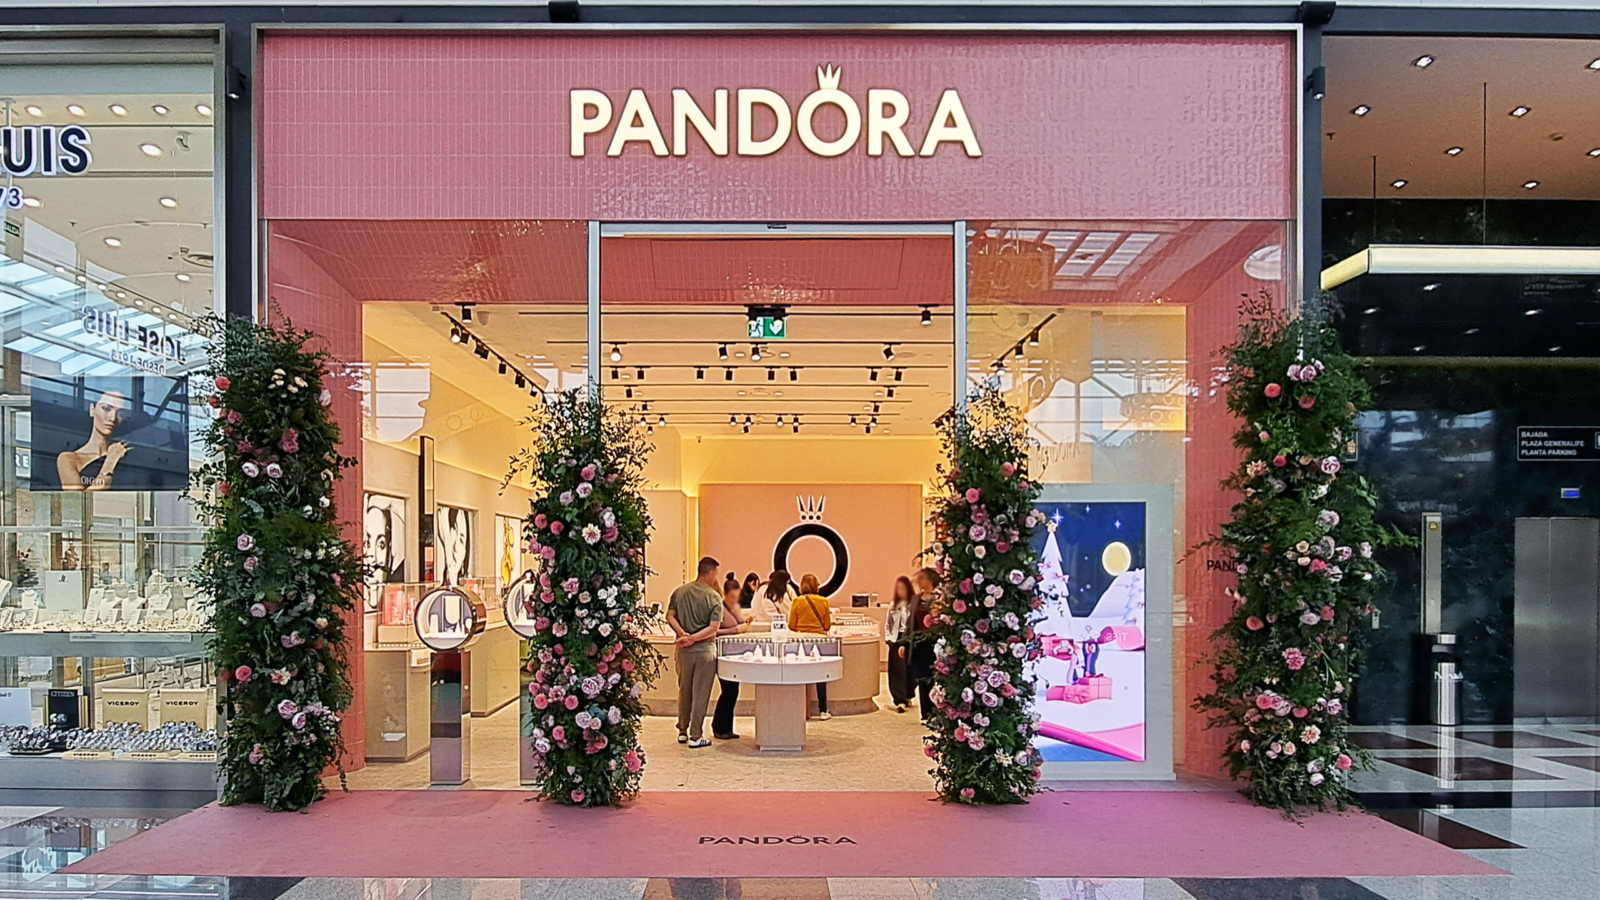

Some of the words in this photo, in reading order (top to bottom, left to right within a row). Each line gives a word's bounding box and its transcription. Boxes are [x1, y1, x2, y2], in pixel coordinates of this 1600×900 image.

[569, 84, 983, 158] PANDORA
[0, 126, 92, 176] UIS
[698, 834, 858, 846] PANDORA
